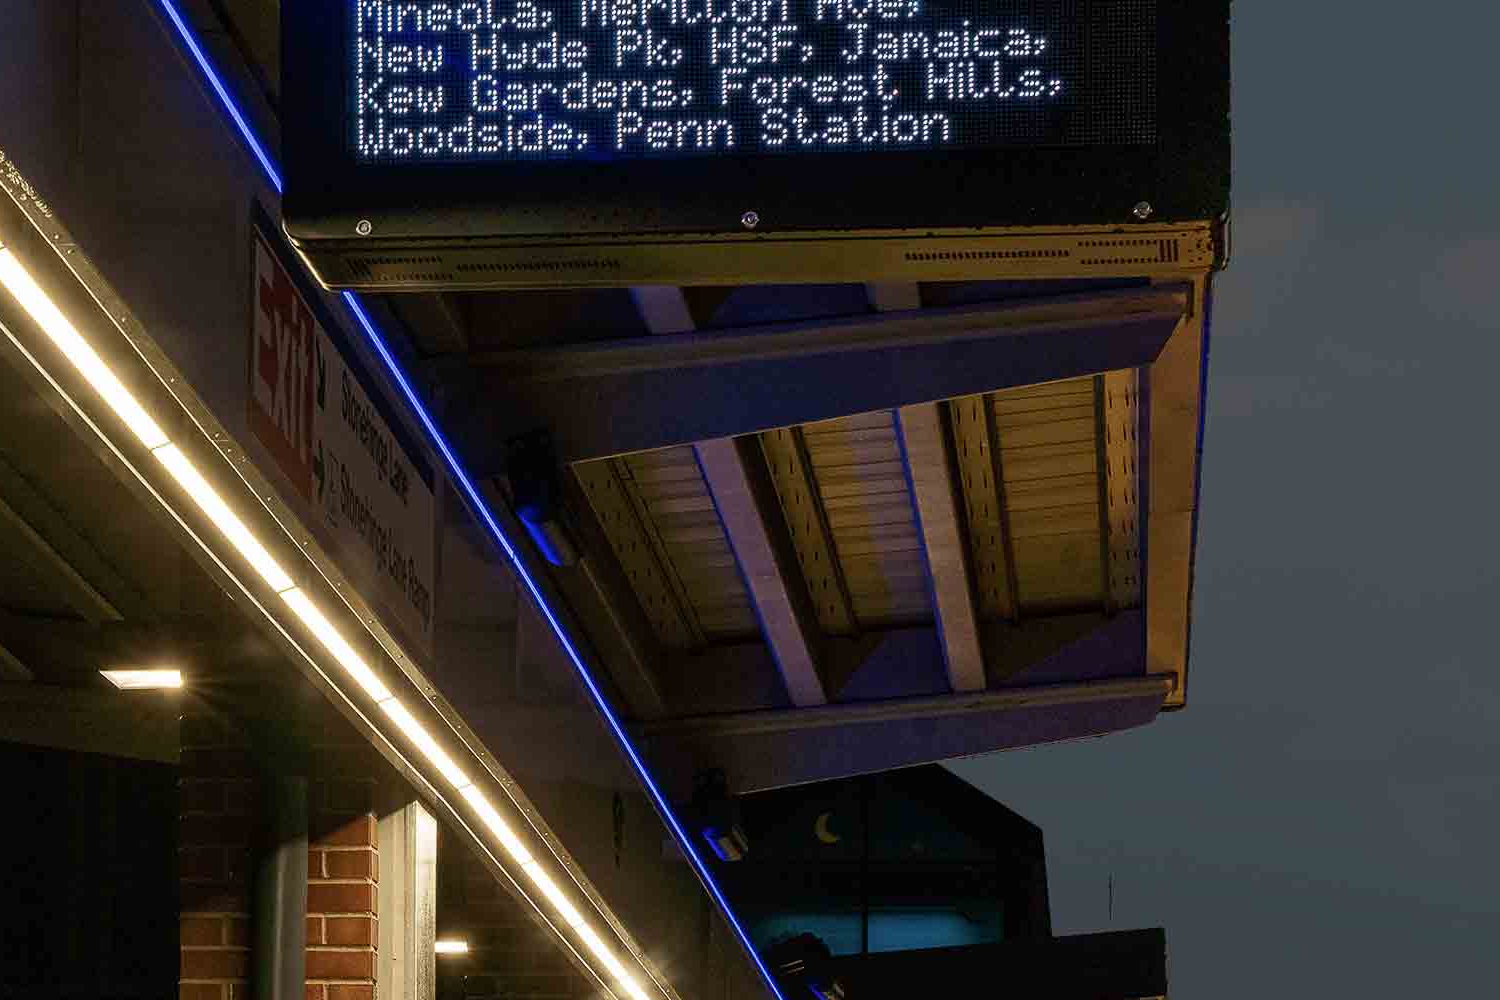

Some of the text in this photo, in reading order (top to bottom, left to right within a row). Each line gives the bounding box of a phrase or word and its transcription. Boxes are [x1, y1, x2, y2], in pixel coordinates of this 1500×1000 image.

[357, 0, 552, 32] Mineola,
[581, 0, 788, 27] Merillon
[357, 20, 1046, 73] New Hyde Pk, HSF, Jamaica,
[357, 60, 1061, 114] Kew Gardens, Forest Hills,
[357, 104, 950, 155] Woodside, Penn Station
